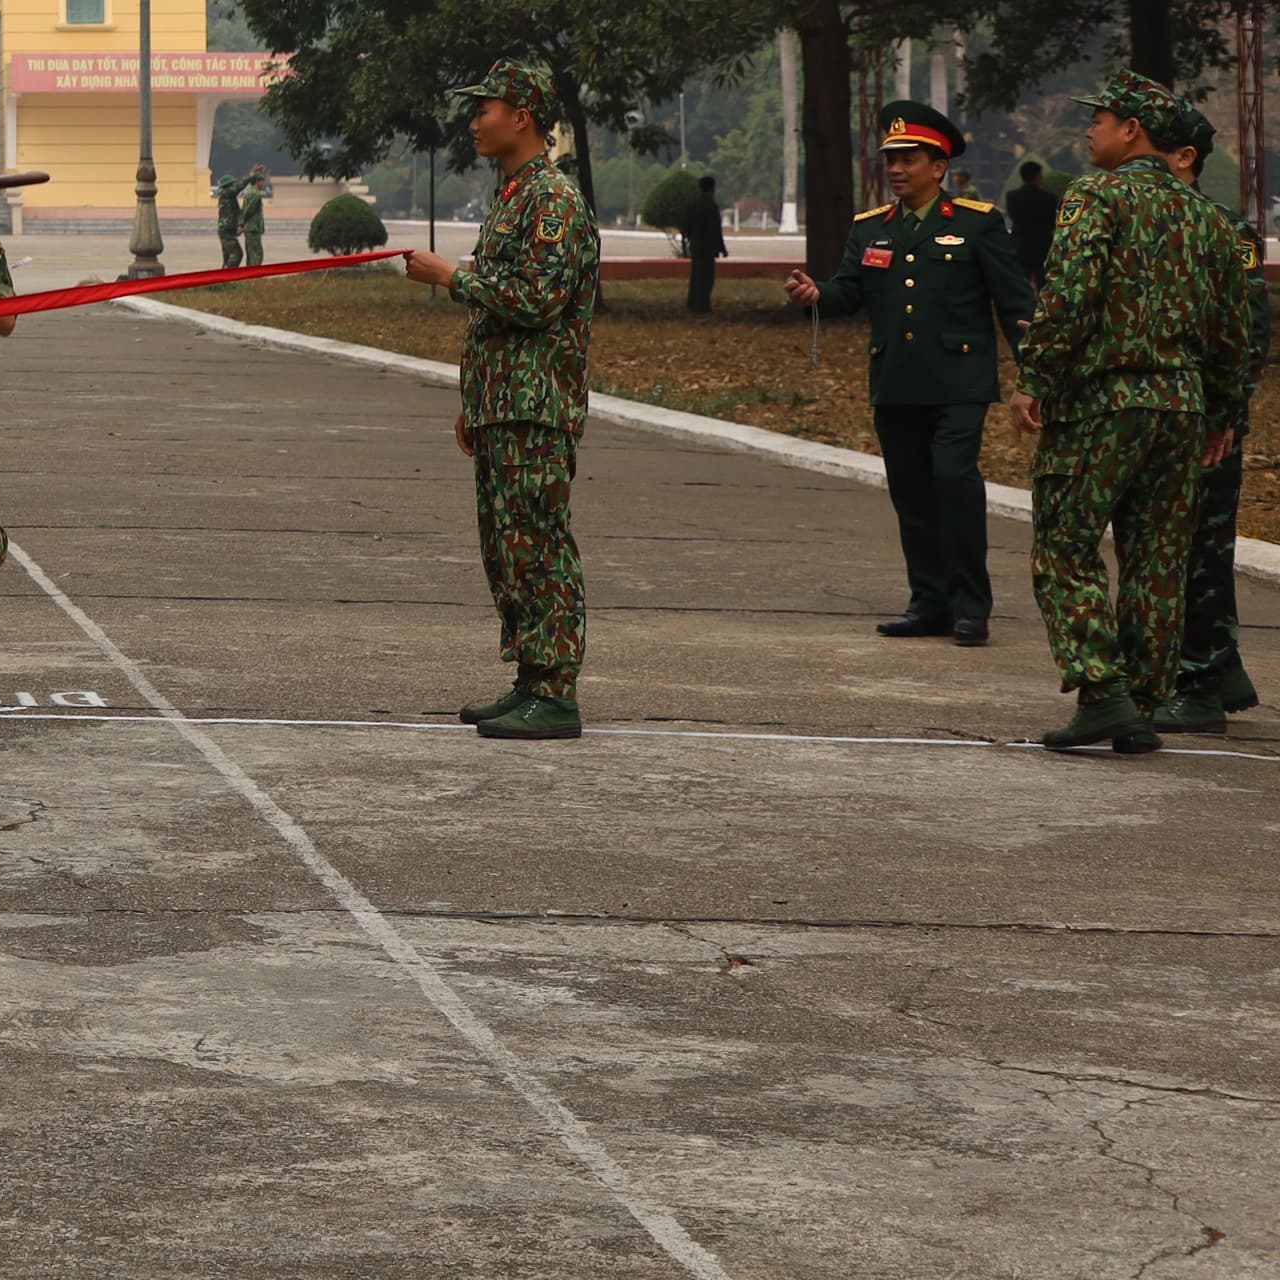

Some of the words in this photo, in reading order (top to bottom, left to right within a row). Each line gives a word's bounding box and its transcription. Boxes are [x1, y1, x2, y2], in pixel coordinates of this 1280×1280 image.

[27, 59, 45, 71] THI
[171, 57, 203, 71] CÔNG
[206, 56, 227, 71] TÁC
[221, 75, 255, 91] MẠNH
